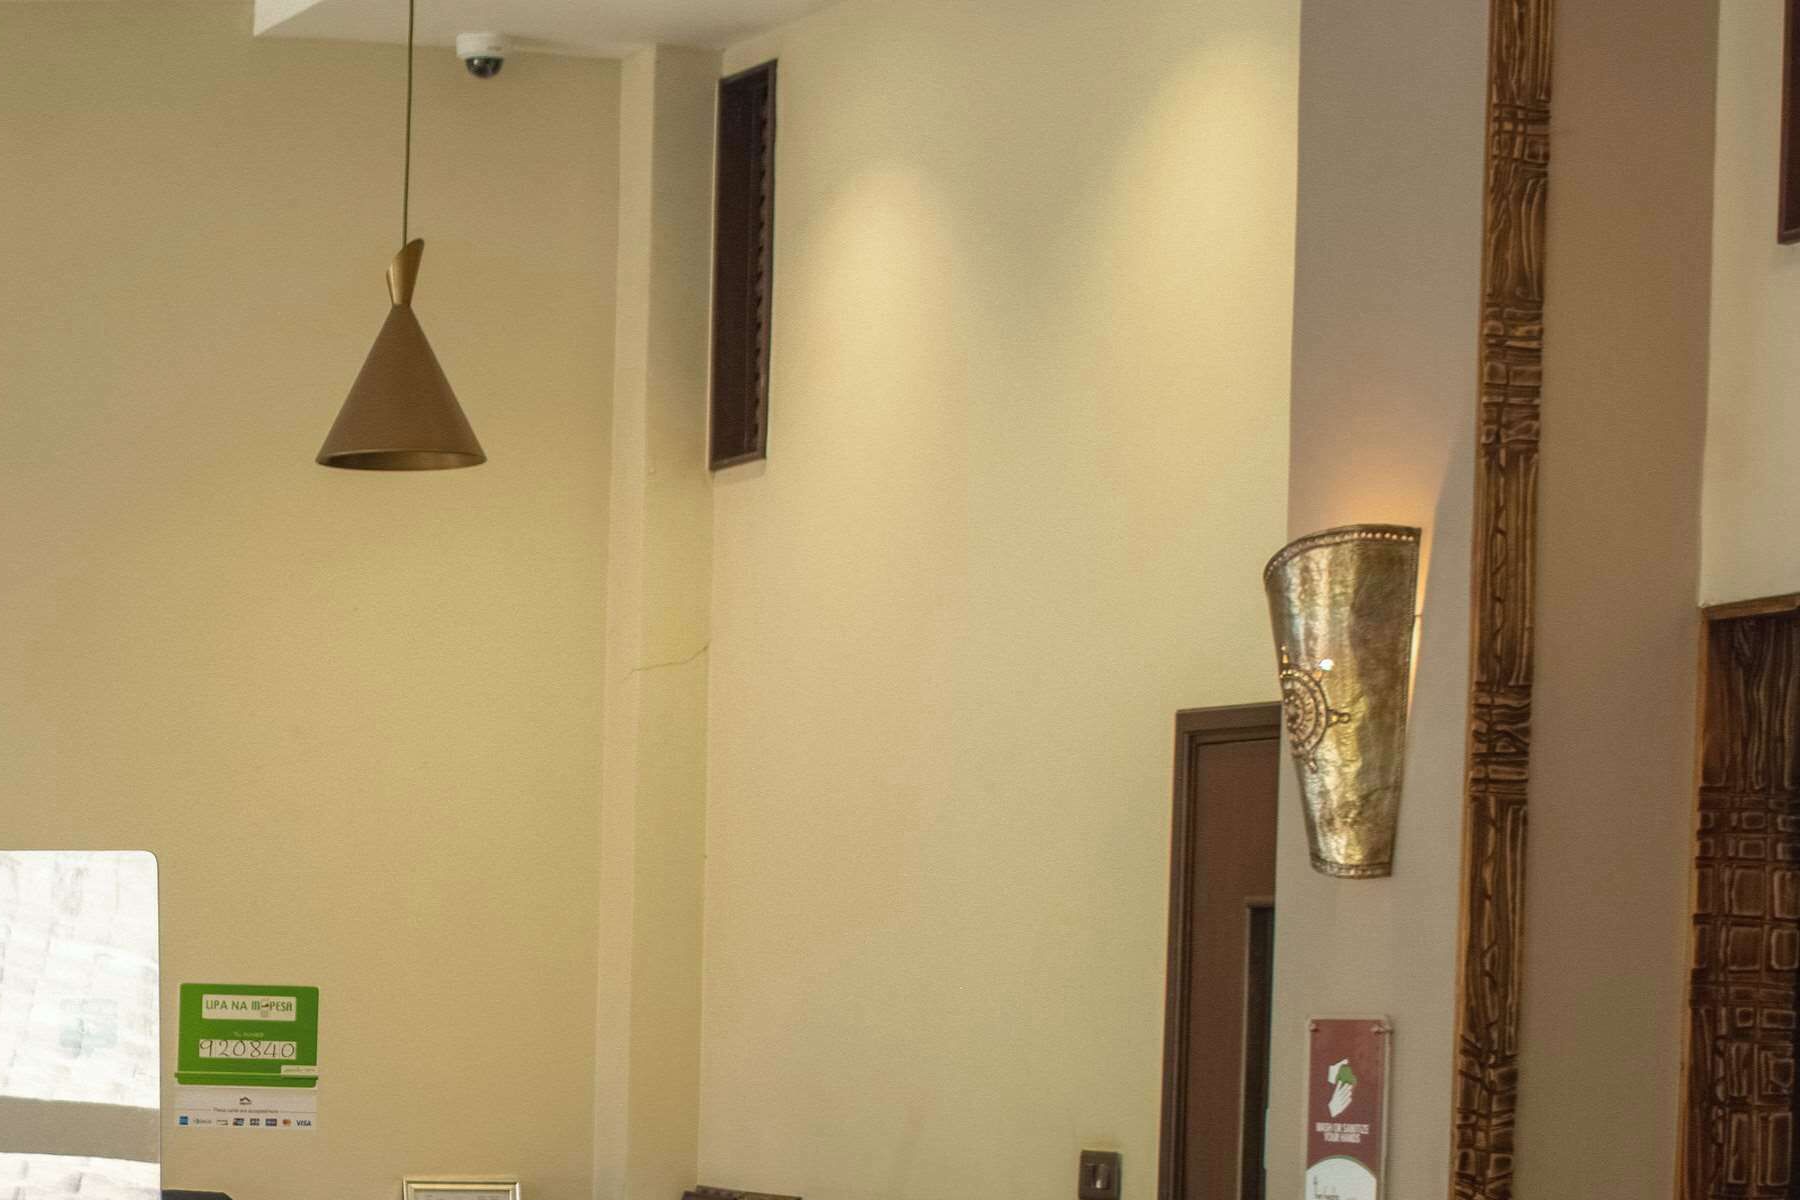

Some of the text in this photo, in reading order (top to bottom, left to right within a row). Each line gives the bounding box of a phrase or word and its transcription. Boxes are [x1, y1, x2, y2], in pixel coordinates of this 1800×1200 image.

[205, 1000, 228, 1010] LIPA
[231, 1000, 247, 1011] NA
[200, 1040, 295, 1058] 920840
